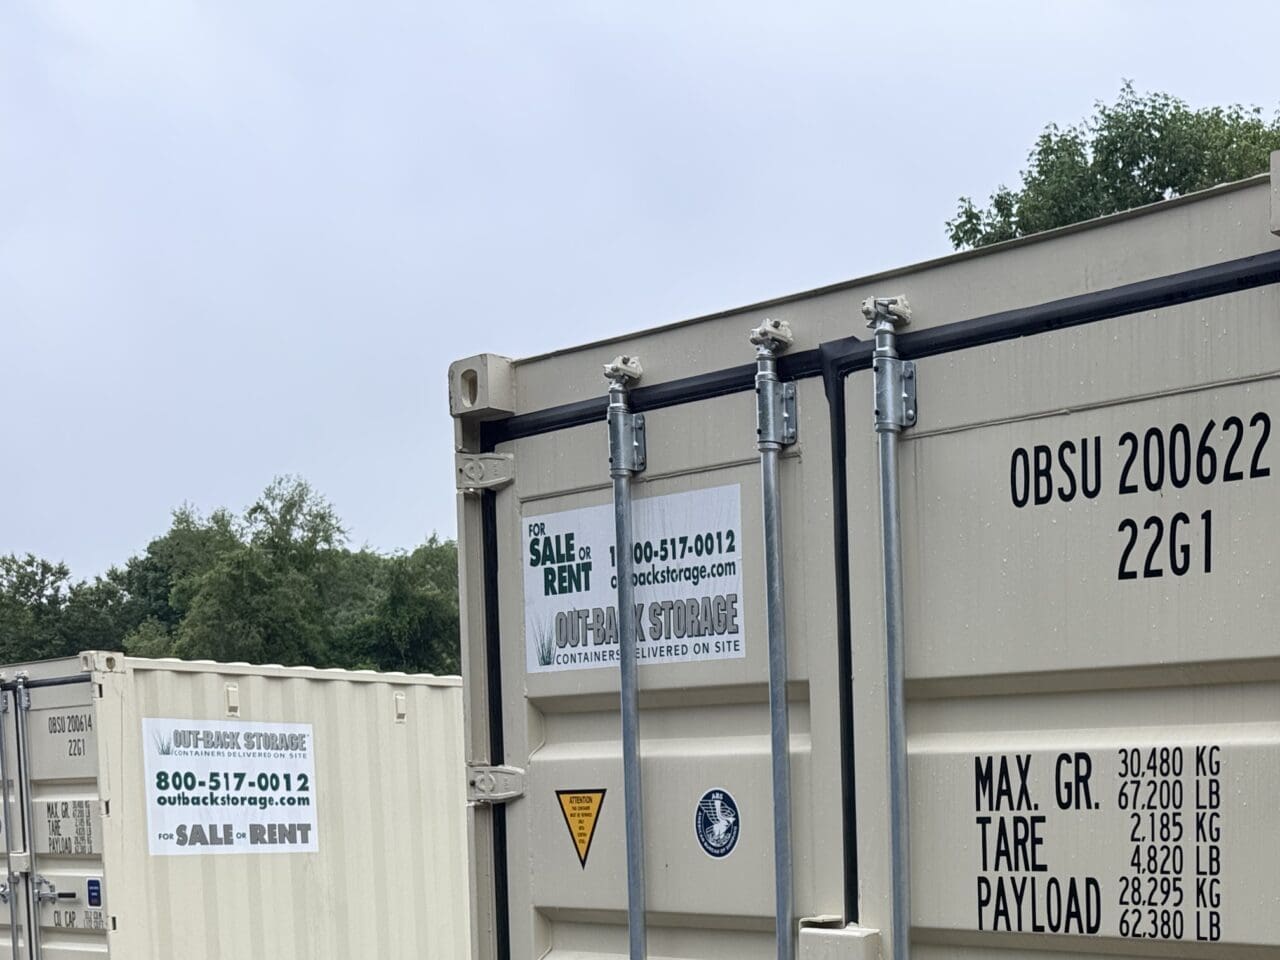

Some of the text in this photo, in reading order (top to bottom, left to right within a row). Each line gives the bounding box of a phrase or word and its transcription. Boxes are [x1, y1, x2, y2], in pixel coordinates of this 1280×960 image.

[1010, 435, 1101, 508] OBSU
[1118, 411, 1271, 495] 200622
[528, 522, 546, 537] FOR
[1118, 509, 1212, 580] 22G1
[529, 532, 591, 567] SALE OR
[609, 529, 736, 567] 100-517-0012
[544, 562, 592, 596] RENT
[555, 593, 739, 648] OUT-BAK STORAGE
[556, 640, 740, 665] CONTAINERS ELIVERED ON SITE
[173, 729, 307, 752] OUT-BACK STORAGE
[174, 750, 226, 758] CONTAINERS
[227, 751, 272, 759] DELIVERED
[156, 771, 310, 792] 800-517-0012
[974, 745, 1221, 812] MAX. GR. 30,480 KG
[1118, 779, 1221, 811] 67,200 LB
[157, 792, 310, 810] outbackstorage.com
[176, 824, 234, 846] SALE
[236, 832, 247, 840] OR
[249, 824, 311, 845] RENT
[976, 812, 1221, 872] TARE 2,185 KG
[1130, 845, 1221, 876] 4,820 LB
[977, 876, 1221, 935] PAYLOAD 28,295 KG
[1118, 908, 1221, 941] 62,380 LB
